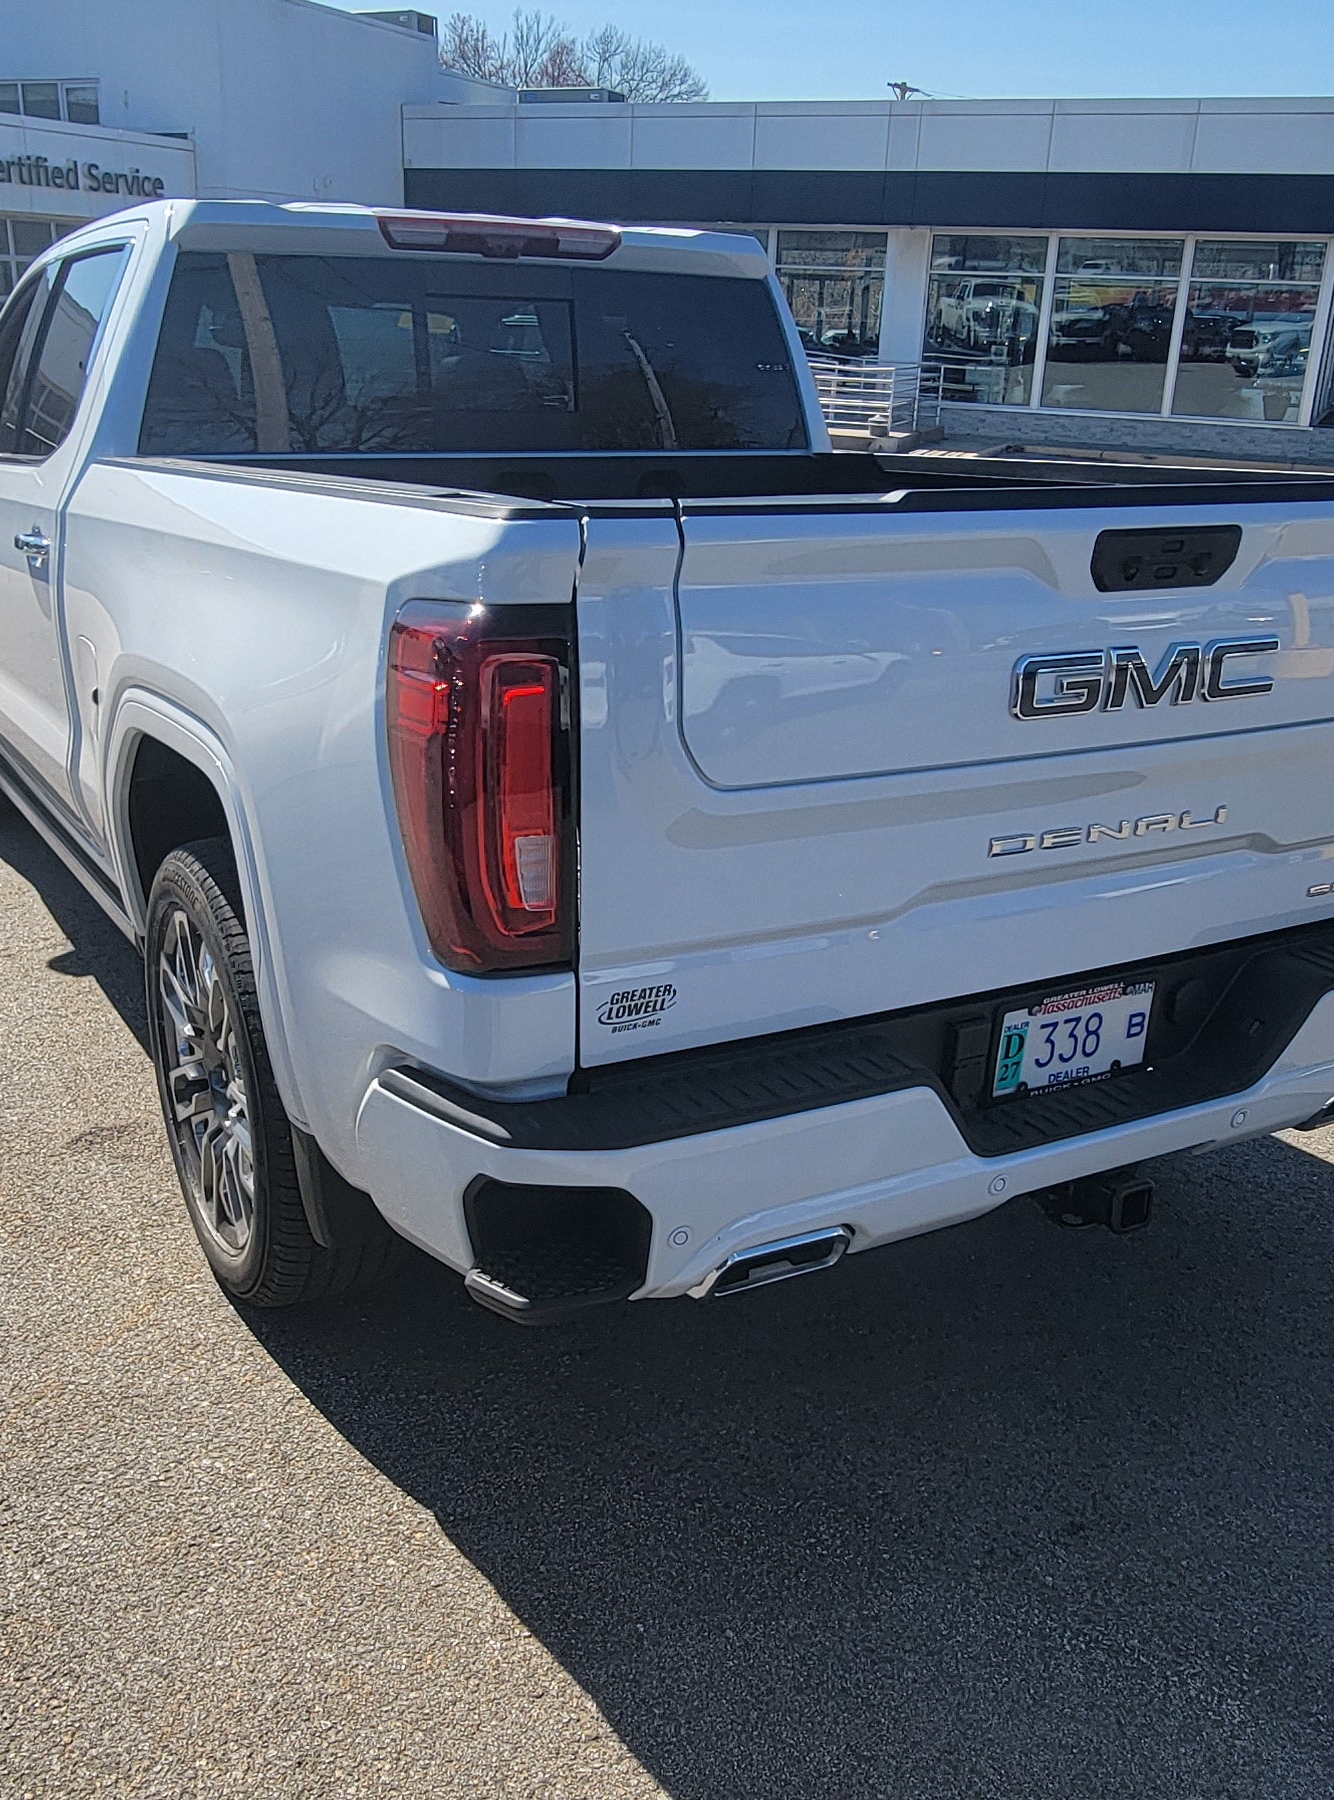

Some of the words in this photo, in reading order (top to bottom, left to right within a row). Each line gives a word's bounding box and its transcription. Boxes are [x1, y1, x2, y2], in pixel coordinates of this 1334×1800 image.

[82, 162, 165, 198] Service
[1009, 634, 1281, 721] GMC
[987, 804, 1228, 858] DENALI
[610, 984, 673, 1006] GREATER
[1043, 989, 1087, 1004] GREATER
[1088, 982, 1125, 994] LOWELL
[606, 998, 667, 1020] LOWELL
[1001, 1033, 1025, 1061] D
[1034, 1012, 1103, 1068] 338
[1126, 1012, 1146, 1039] B
[998, 1061, 1021, 1082] 27
[1048, 1066, 1090, 1084] DEALER
